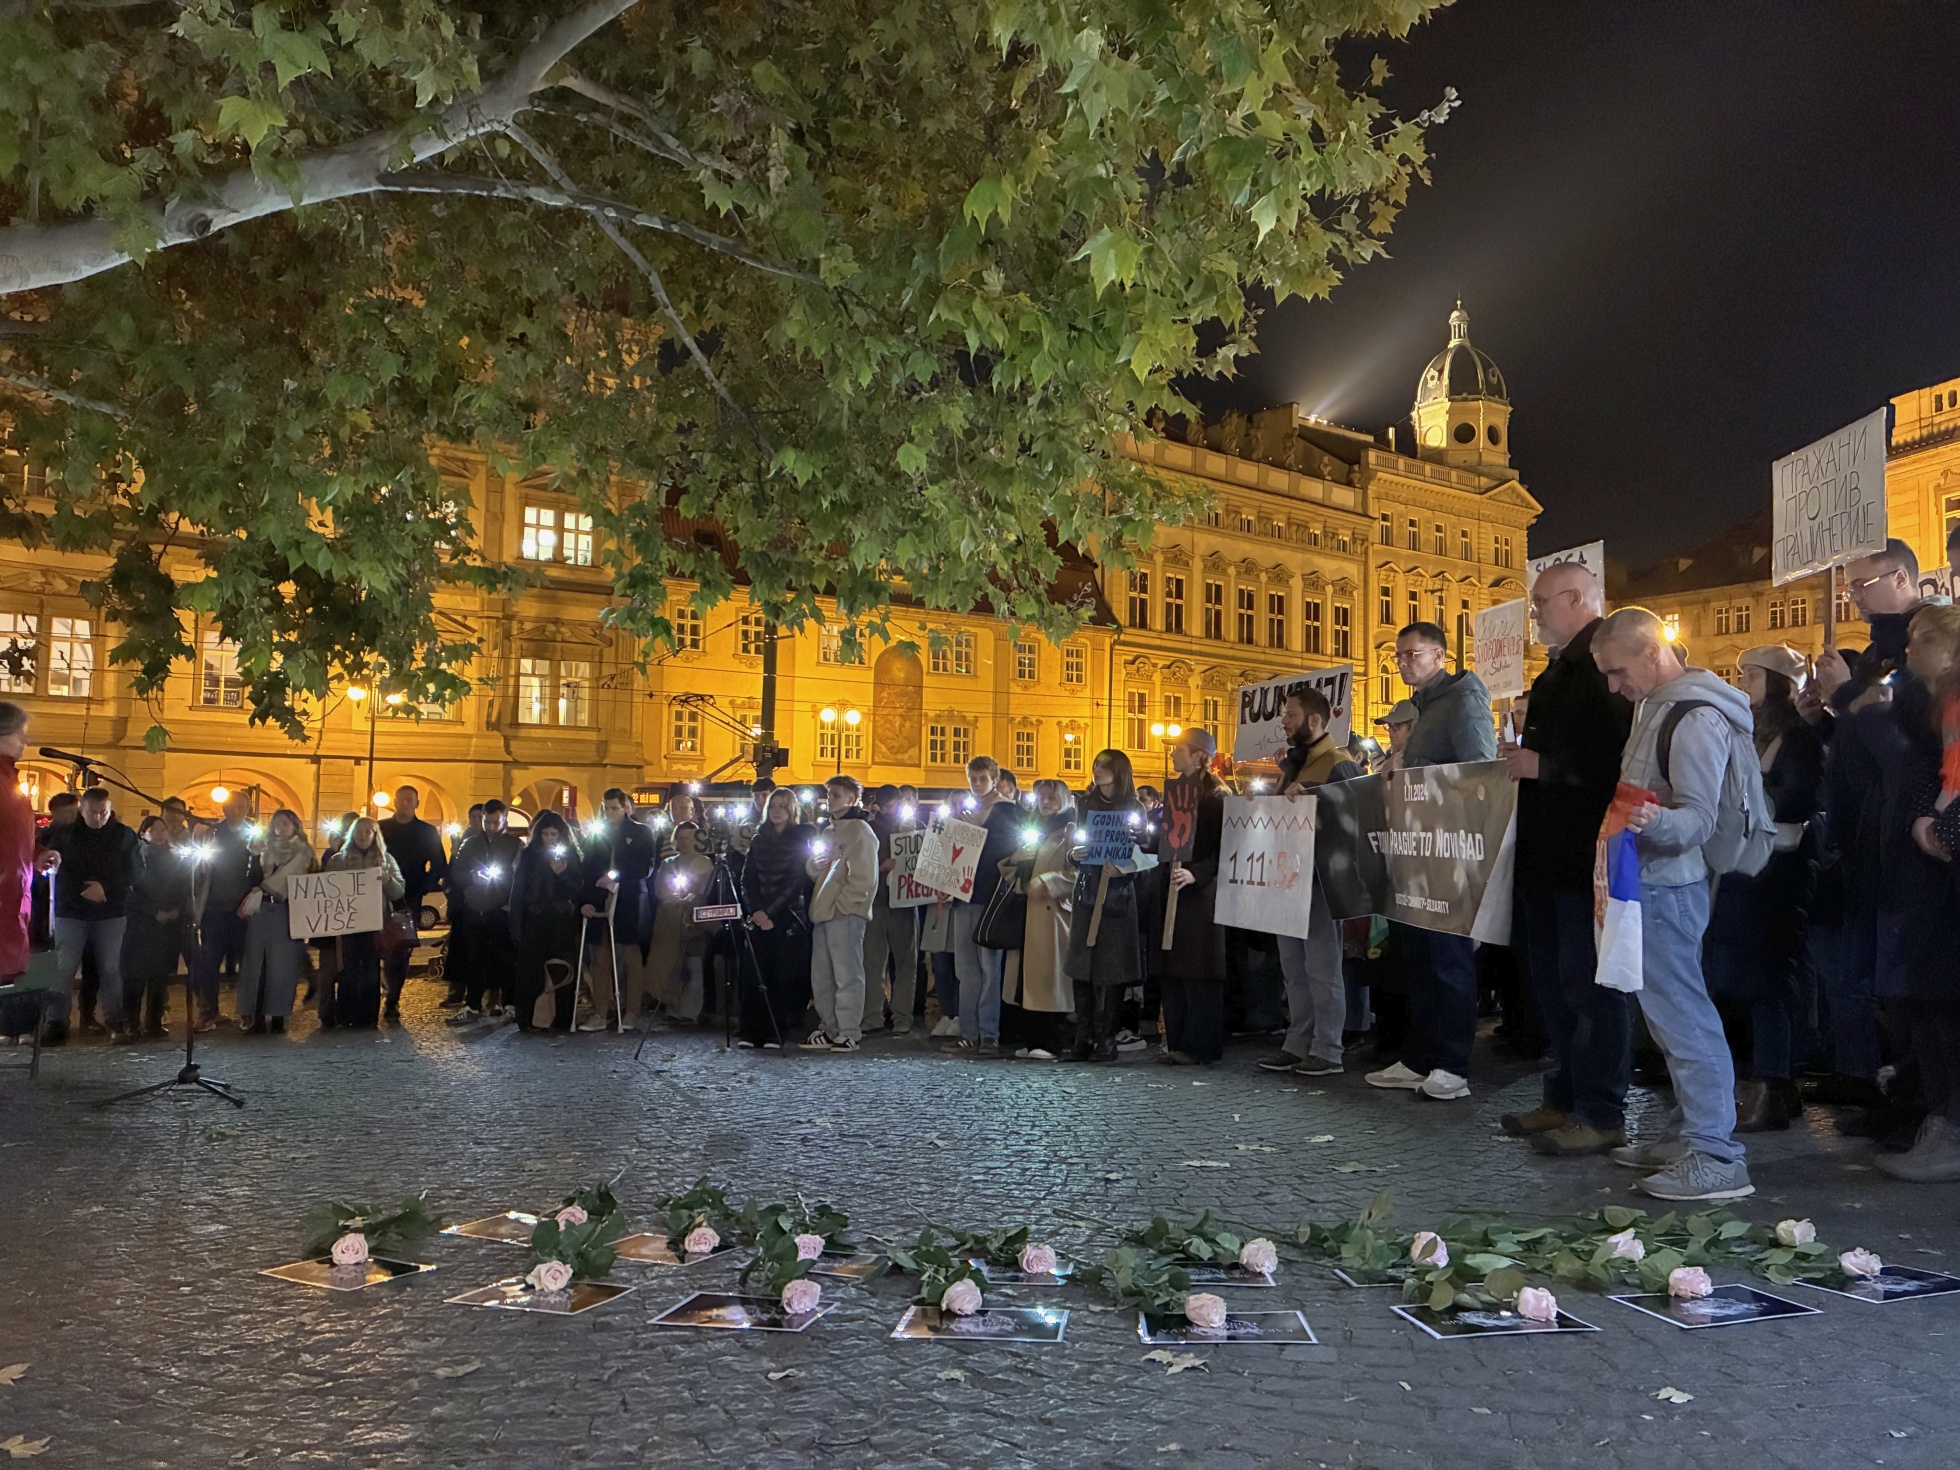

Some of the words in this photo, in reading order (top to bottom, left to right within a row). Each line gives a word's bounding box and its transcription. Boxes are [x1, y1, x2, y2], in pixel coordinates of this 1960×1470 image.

[1781, 425, 1867, 499] ПРАЖАНИ
[1784, 470, 1862, 532] ПРОТИВ
[1774, 501, 1876, 574] ПРАШИНЕРИЈЕ
[1092, 814, 1127, 827] GODIN
[894, 832, 924, 856] STUD
[922, 839, 943, 862] JE
[1389, 828, 1417, 857] PRAGUE
[1419, 831, 1433, 857] TO
[1435, 827, 1459, 859] NOVI
[1459, 829, 1485, 861] SAD
[904, 856, 917, 873] KO
[920, 860, 960, 889] OTPOR
[295, 873, 341, 900] NAS
[346, 871, 366, 897] JE
[897, 873, 940, 900] PREGA
[317, 897, 357, 914] IPAK
[306, 911, 357, 933] VISE
